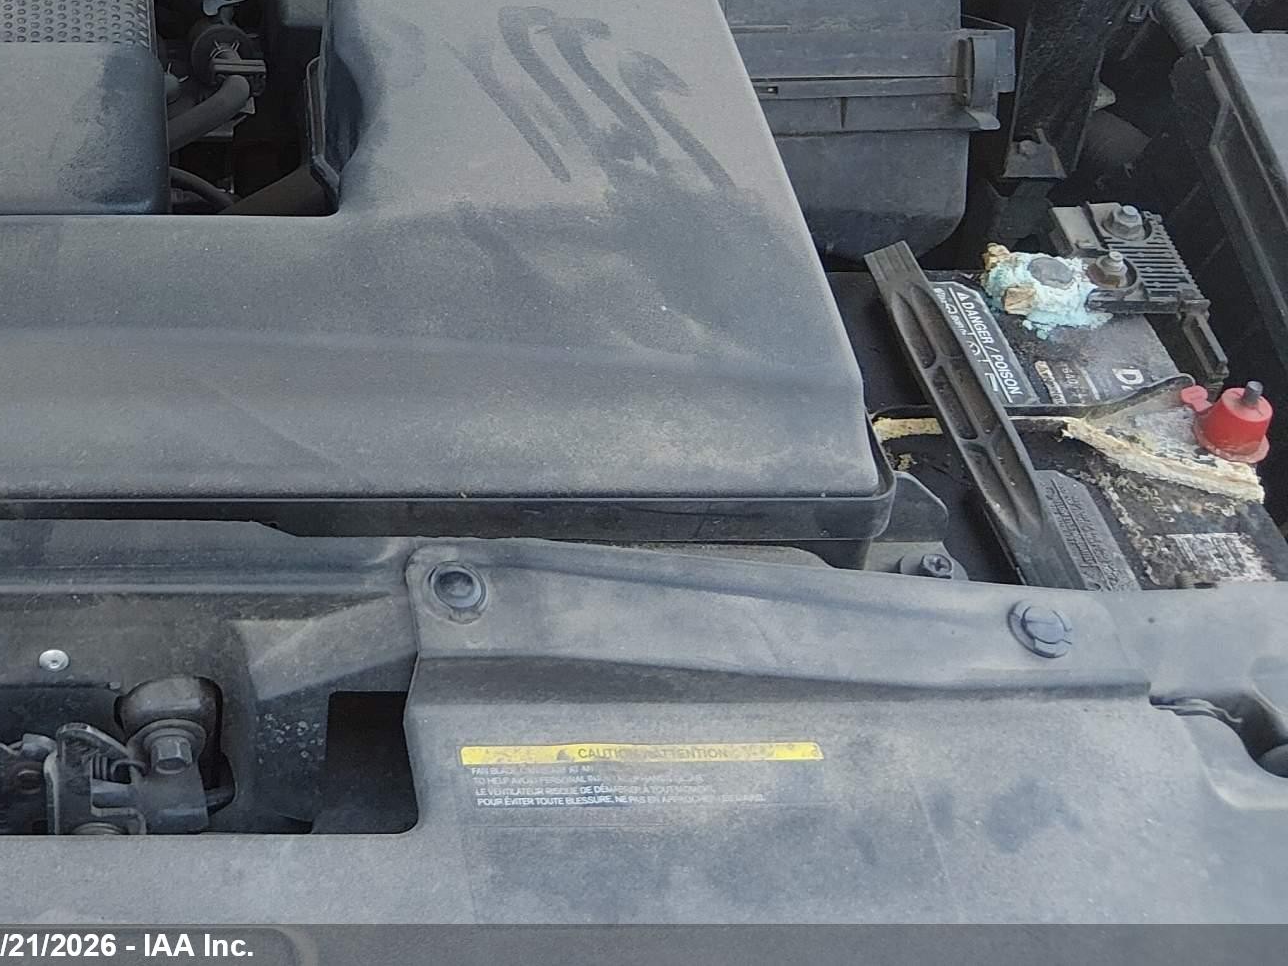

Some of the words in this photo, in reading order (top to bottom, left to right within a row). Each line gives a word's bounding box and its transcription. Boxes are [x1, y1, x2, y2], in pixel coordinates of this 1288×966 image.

[961, 302, 995, 345] DANGER
[991, 353, 1024, 396] POISON
[477, 797, 503, 806] POUR
[504, 795, 535, 805] ÉVITER
[536, 797, 565, 805] TOUTE
